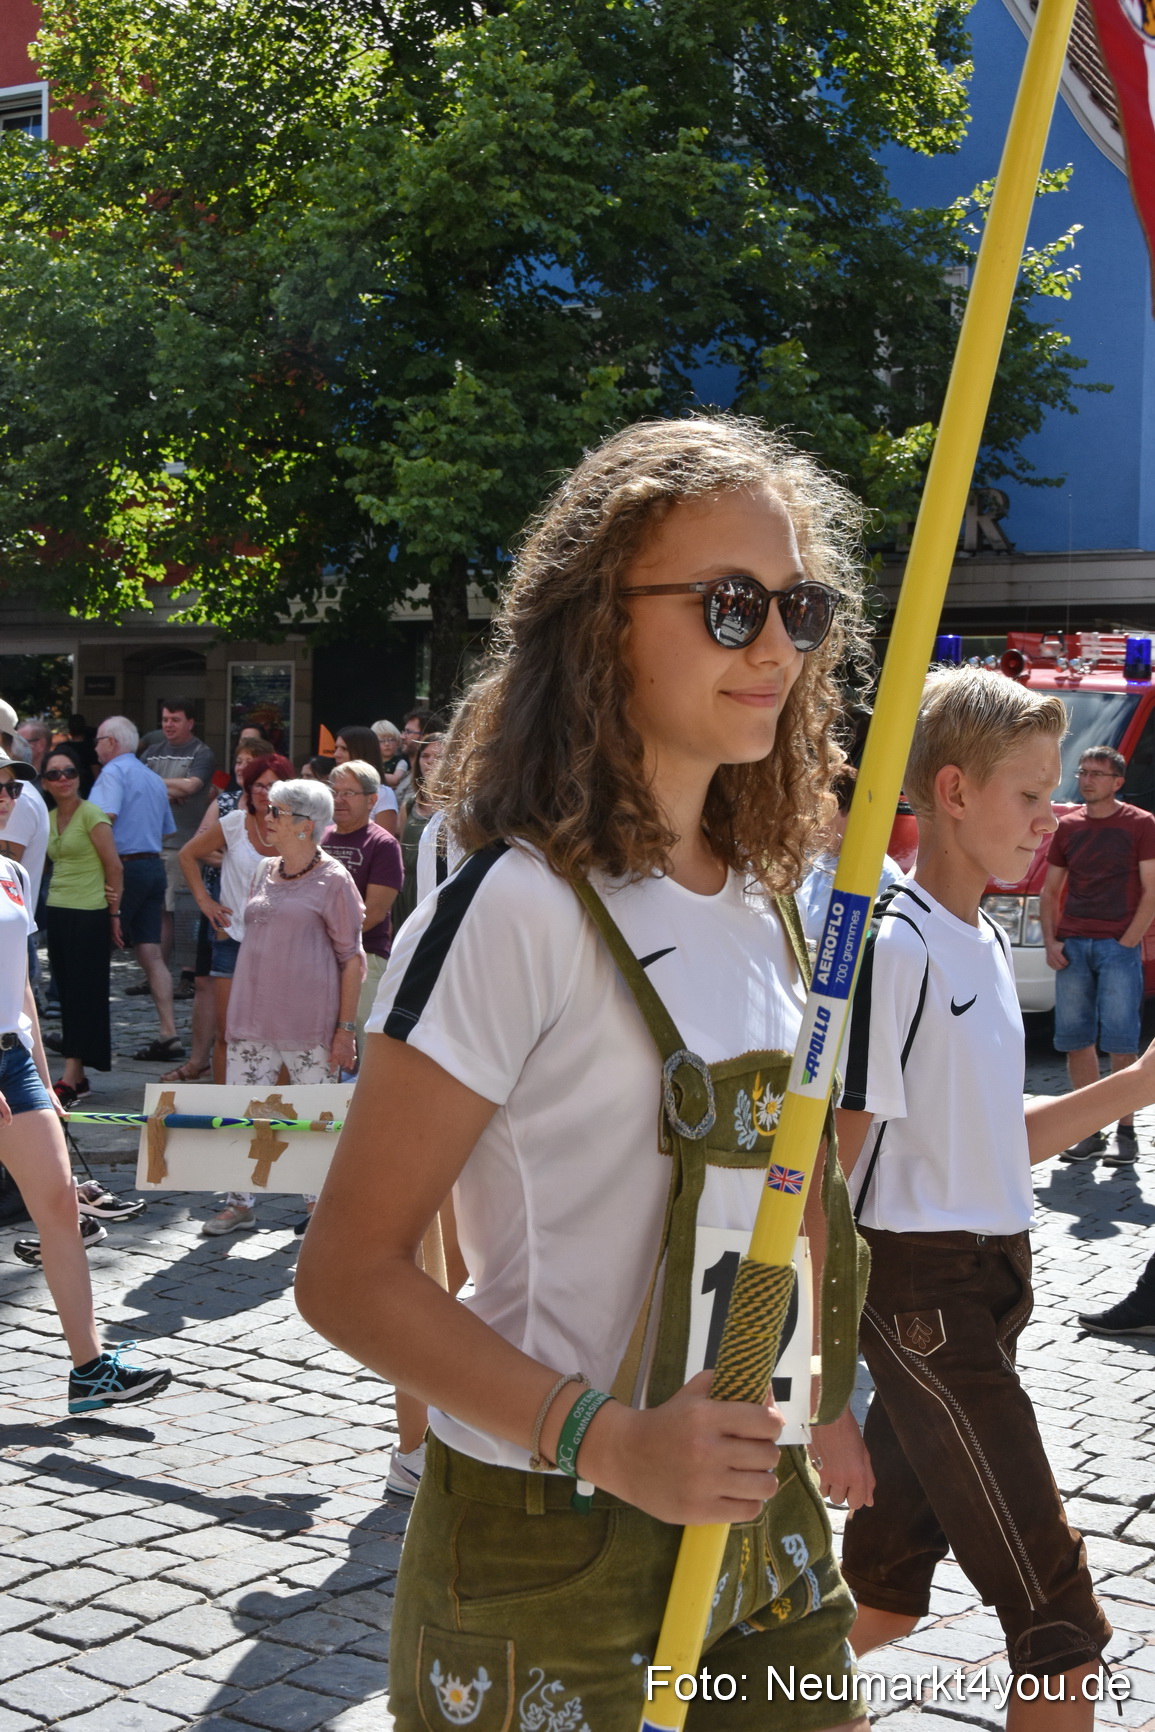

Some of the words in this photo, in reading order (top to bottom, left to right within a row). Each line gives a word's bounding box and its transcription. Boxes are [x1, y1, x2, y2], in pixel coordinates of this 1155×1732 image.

[817, 903, 845, 985] AEROFLO
[835, 963, 849, 985] 700
[842, 909, 861, 962] grammes
[804, 1005, 831, 1084] APOLLO
